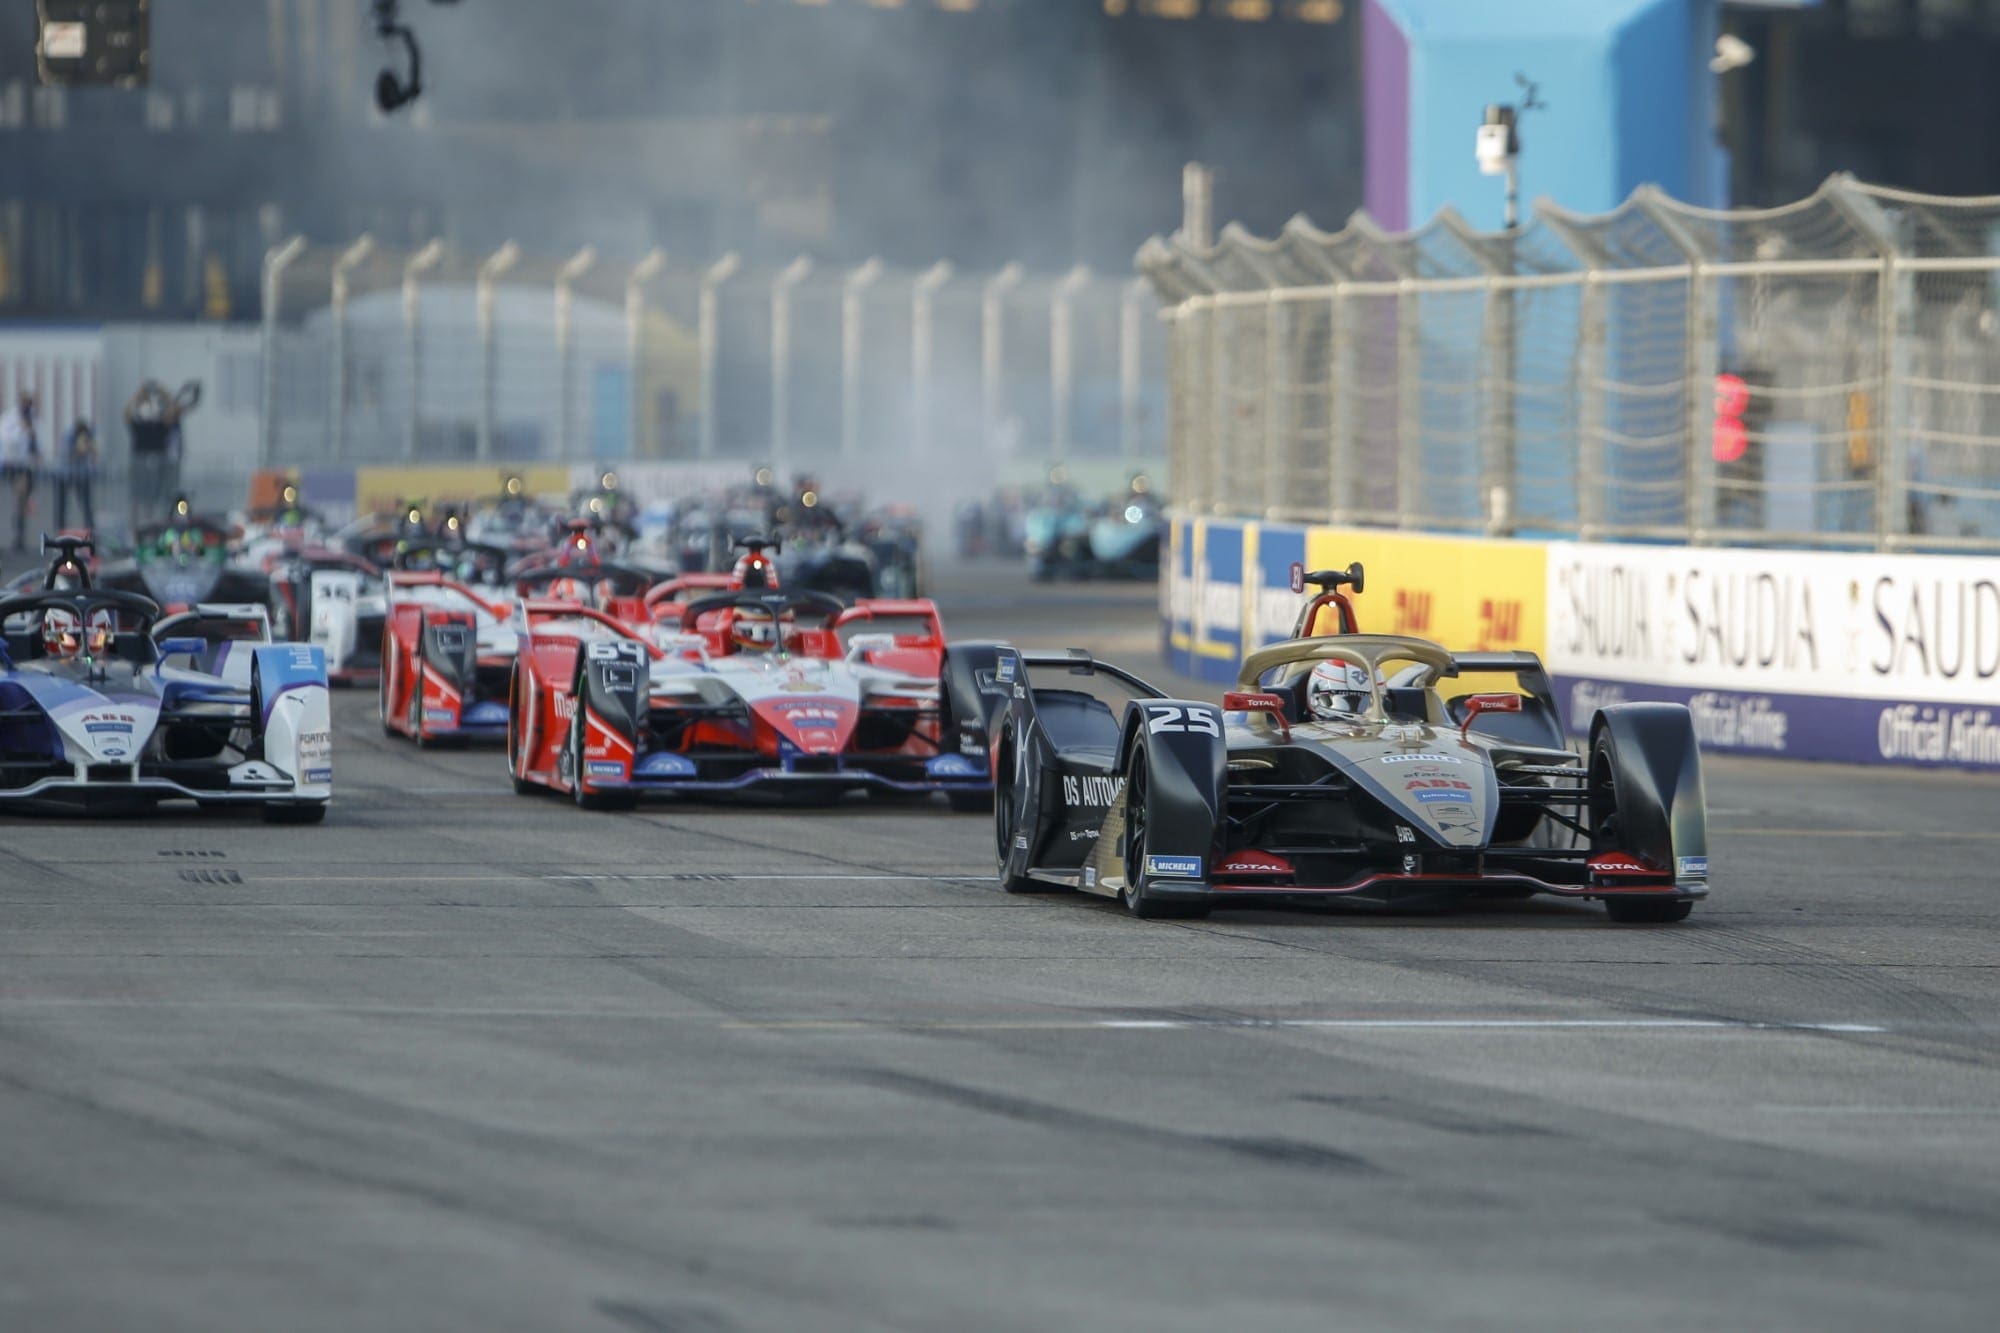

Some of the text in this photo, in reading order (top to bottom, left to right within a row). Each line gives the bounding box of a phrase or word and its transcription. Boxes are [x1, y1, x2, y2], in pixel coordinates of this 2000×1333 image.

[1569, 563, 1652, 660] SAUDIA
[1681, 568, 1820, 672] SAUDIA
[1871, 575, 2000, 680] SAUD
[1247, 699, 1275, 707] TOTAL
[1148, 706, 1220, 738] 25
[1878, 703, 1950, 760] Official
[1062, 775, 1080, 806] DS
[1404, 779, 1473, 791] ABB
[1158, 862, 1197, 871] MICHELIN
[1225, 863, 1283, 872] TOTAL
[1590, 863, 1646, 872] TOTAL
